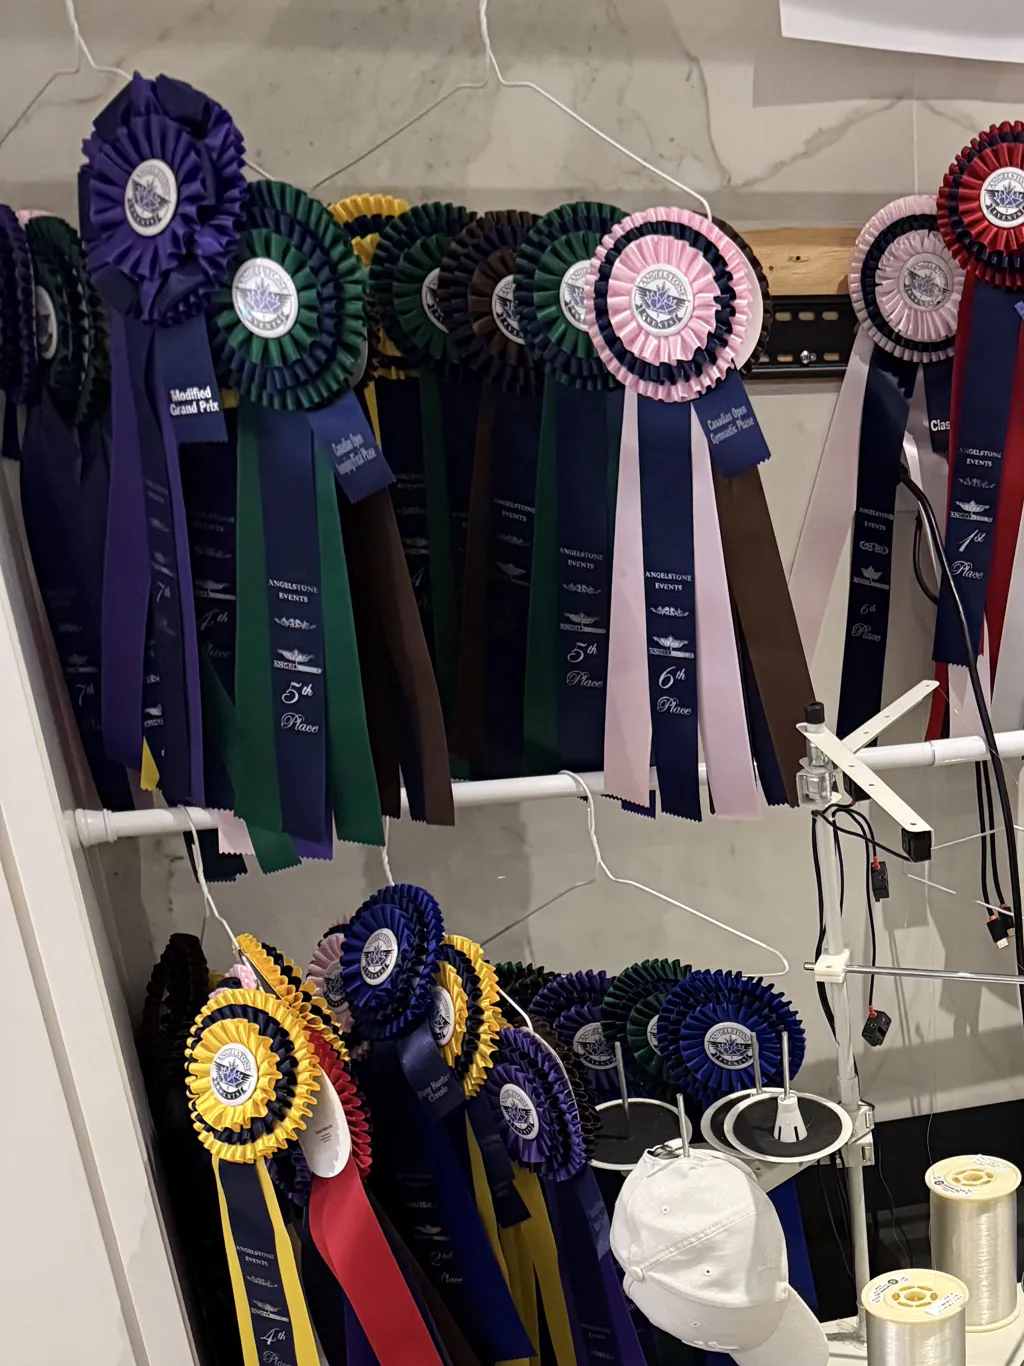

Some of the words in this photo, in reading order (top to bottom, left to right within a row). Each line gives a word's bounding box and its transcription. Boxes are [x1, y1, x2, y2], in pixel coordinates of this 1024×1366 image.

[991, 209, 1022, 221] EVENTS
[641, 269, 687, 298] ANGELSTONE
[641, 312, 676, 330] EVENTS
[170, 385, 212, 402] Modified
[170, 401, 198, 416] Grand
[199, 398, 220, 414] Prix
[707, 411, 732, 431] Canadian
[731, 405, 748, 420] Open
[736, 415, 755, 432] Phase
[930, 418, 951, 433] Clas
[959, 447, 1002, 459] ANGELSTONE
[966, 457, 992, 467] EVENTS
[501, 510, 527, 522] EVENTS
[864, 519, 887, 531] EVENTS
[959, 529, 987, 552] 1st
[559, 547, 603, 561] ANGELSTONE
[567, 559, 595, 570] EVENTS
[950, 560, 985, 581] Place
[645, 571, 692, 582] ANGELSTONE
[156, 581, 172, 604] 7th
[268, 579, 319, 594] ANGELSTONE
[655, 582, 683, 591] EVENTS
[279, 592, 309, 603] EVENTS
[852, 623, 882, 642] Place
[567, 642, 598, 663] 5th
[566, 670, 603, 688] Place
[658, 666, 687, 689] 6th
[76, 683, 96, 707] 7th
[282, 682, 313, 704] 5th
[657, 696, 692, 716] Place
[281, 712, 319, 733] Place
[219, 1048, 251, 1072] ANGELSTONE
[718, 1055, 747, 1067] EVENTS
[236, 1245, 276, 1260] ANGELSTONE
[245, 1255, 269, 1267] EVENTS
[260, 1327, 287, 1346] 4th
